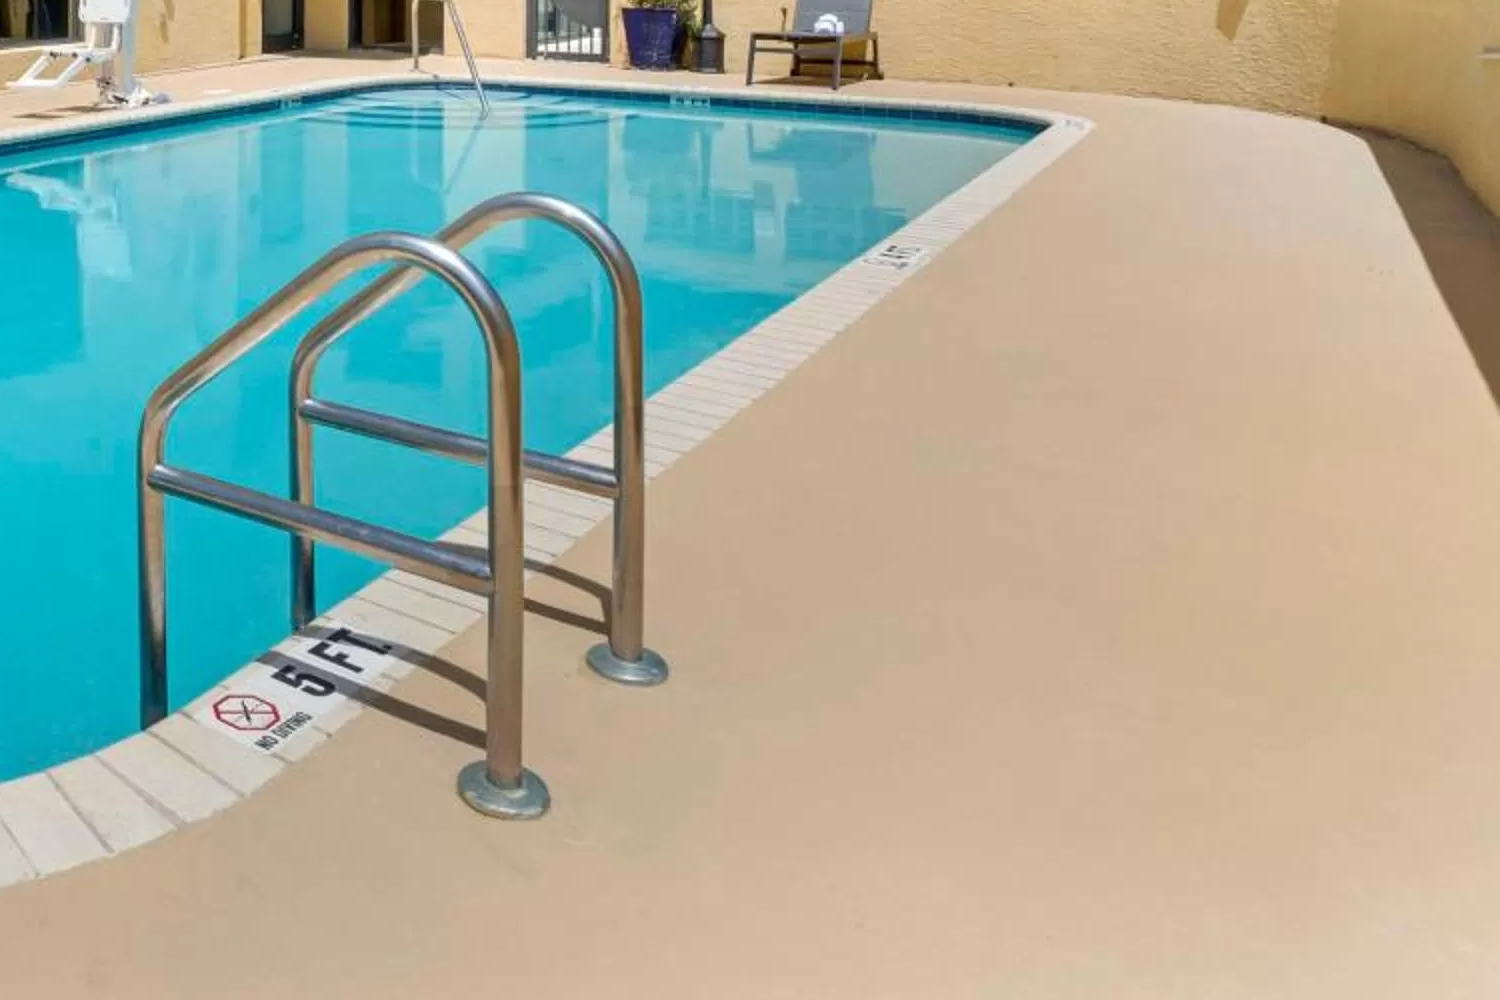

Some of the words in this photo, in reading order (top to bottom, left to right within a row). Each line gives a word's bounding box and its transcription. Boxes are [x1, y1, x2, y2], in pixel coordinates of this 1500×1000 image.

[271, 664, 336, 697] 5
[254, 735, 279, 751] NO
[271, 711, 312, 739] DIVING
